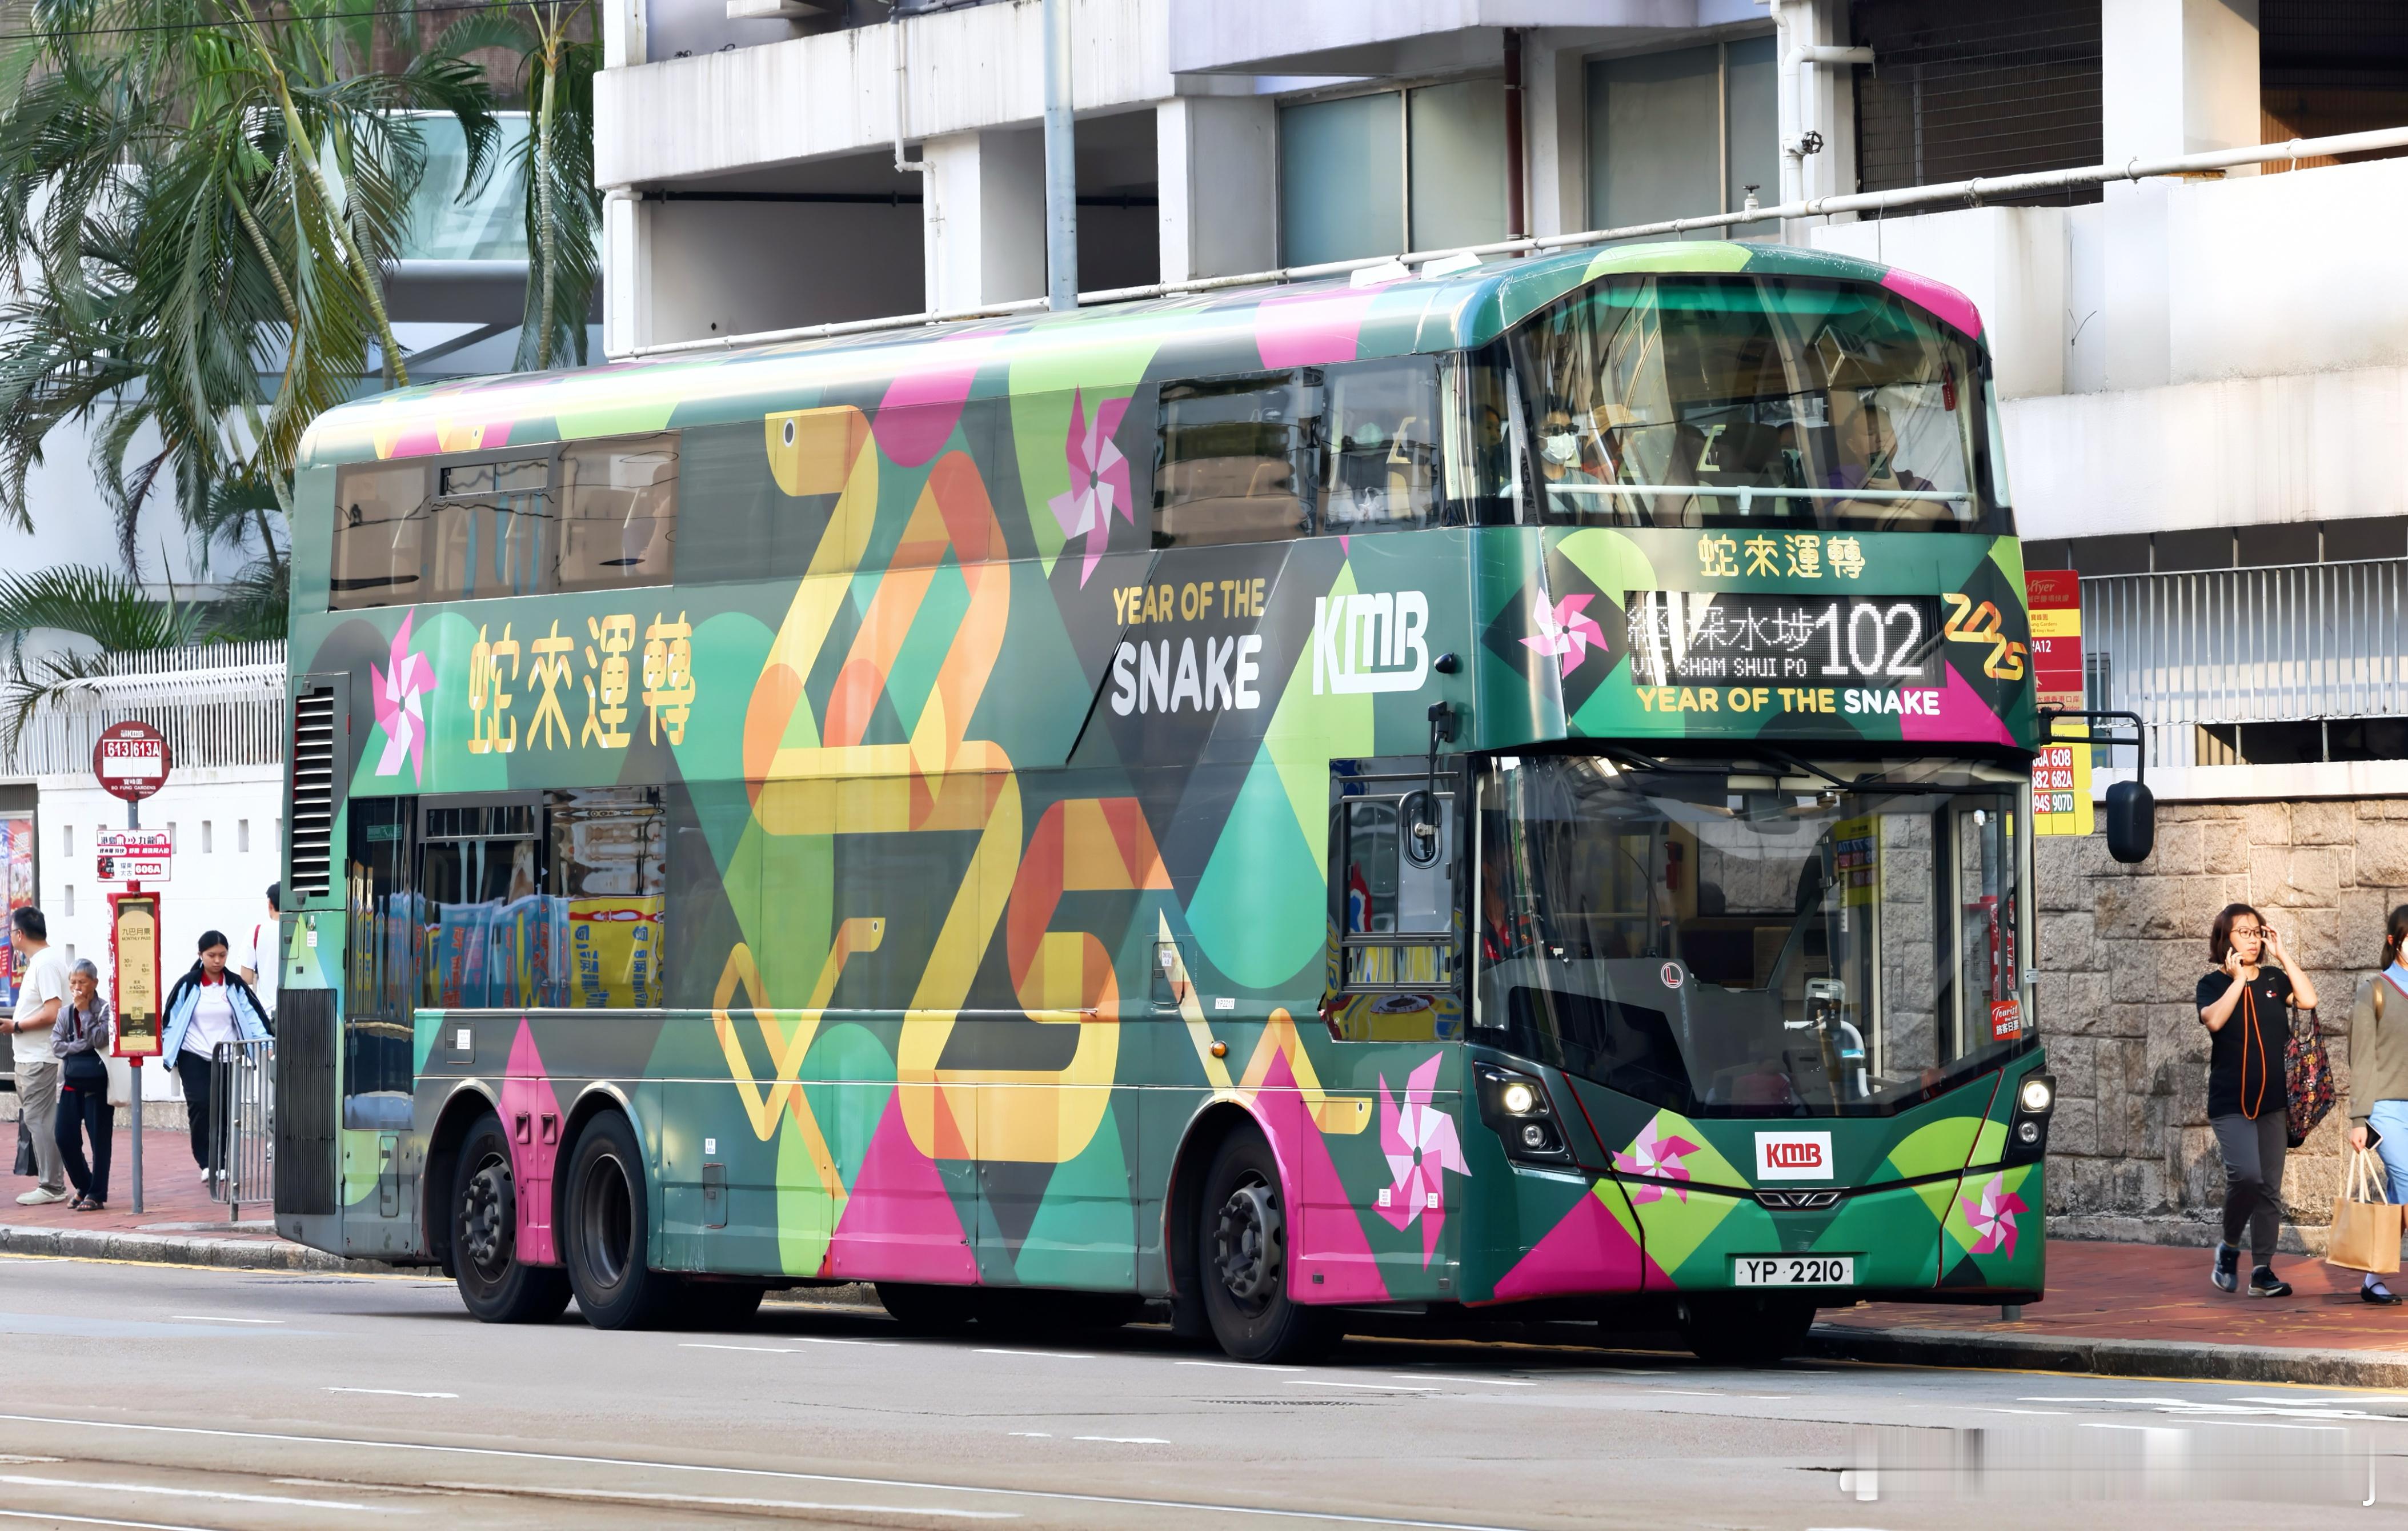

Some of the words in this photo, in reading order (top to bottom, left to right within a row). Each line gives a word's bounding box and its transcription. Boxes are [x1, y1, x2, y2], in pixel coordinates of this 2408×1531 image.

[1698, 534, 1865, 579] 蛇來運轉
[1113, 583, 1173, 625] YEAR
[1181, 582, 1214, 622] OF
[1220, 578, 1265, 618] THE
[1313, 591, 1429, 695] KMB
[1816, 603, 1922, 676] 102
[1111, 634, 1262, 716] SNAKE
[1678, 658, 1725, 676] SHAM
[1734, 658, 1777, 676] SHUI
[1785, 658, 1806, 677] PO
[468, 610, 695, 754] 蛇來運轉
[1637, 688, 1718, 712] YEAR
[1728, 688, 1769, 712] OF
[1778, 688, 1836, 714] THE
[1844, 690, 1940, 715] SNAKE
[107, 743, 129, 756] 613
[134, 743, 159, 756] 613A
[2052, 749, 2071, 767] 608
[2052, 771, 2073, 788] 682A
[2032, 795, 2050, 812] 94S
[2053, 793, 2073, 811] 907D
[135, 865, 161, 873] 606A
[1666, 966, 1679, 984] L
[1992, 1005, 2017, 1021] Tourist
[1996, 1020, 2020, 1035] 旅客日票
[1766, 1143, 1822, 1168] KMB
[1747, 1261, 1777, 1282] YP
[1790, 1260, 1843, 1282] 2210
